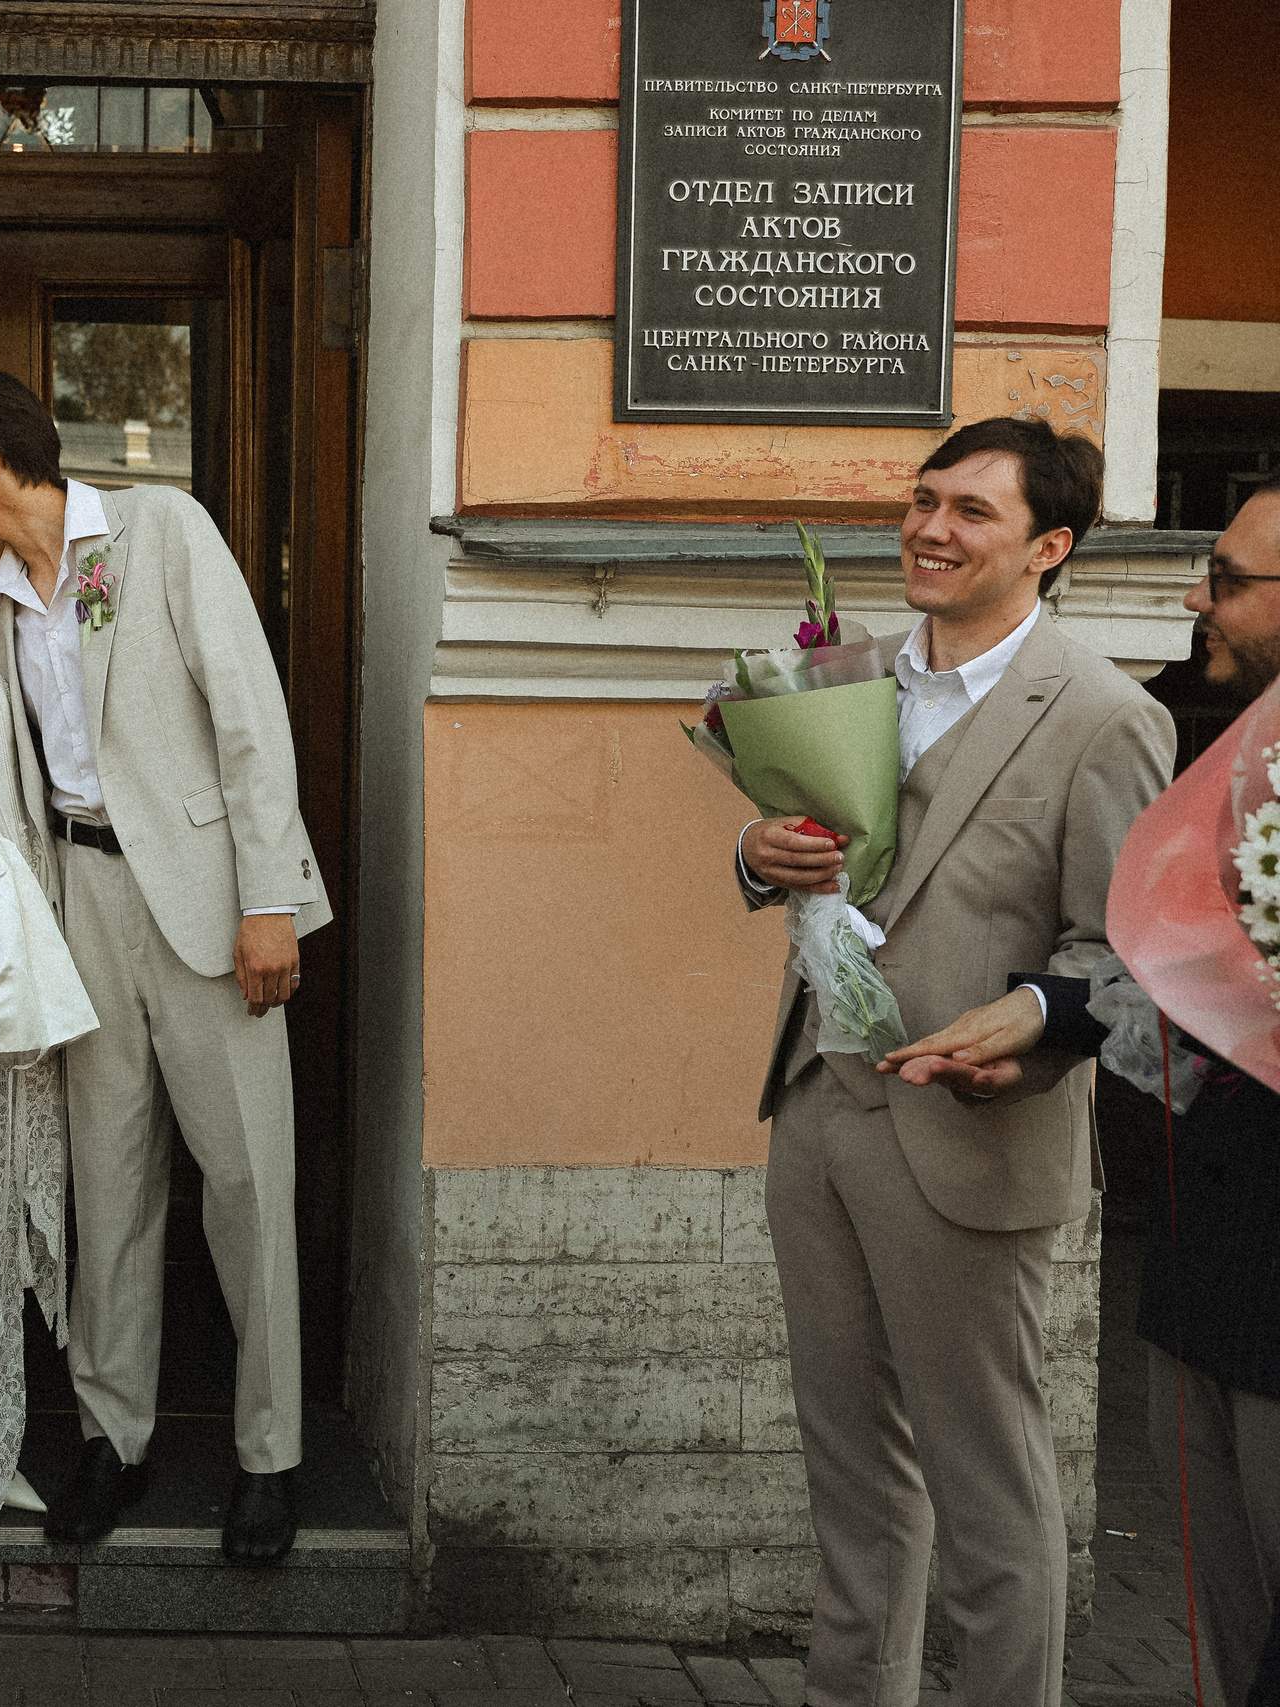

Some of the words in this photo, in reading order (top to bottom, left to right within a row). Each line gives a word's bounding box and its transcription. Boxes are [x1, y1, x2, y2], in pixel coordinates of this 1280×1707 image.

[644, 80, 778, 93] ПРАВИТЕЛЬСТВО
[790, 82, 942, 96] САНКТ-ПЕТЕРБУРГА
[710, 108, 783, 121] КОМИТЕТ
[792, 110, 813, 121] ПО
[821, 110, 877, 124] ДЕЛАМ
[664, 125, 727, 137] ЗАПИСИ
[737, 126, 785, 138] АКТОВ
[794, 127, 921, 141] ГРАЖДАНСКОГО
[745, 144, 840, 157] СОСТОЯНИЯ
[668, 180, 774, 207] ОТДЕЛ
[794, 182, 914, 205] ЗАПИСИ
[741, 216, 841, 239] АКТОВ
[662, 249, 916, 277] ГРАЖДАНСКОГО
[695, 285, 881, 309] СОСТОЯНИЯ
[643, 330, 829, 351] ЦЕНТРАЛЬНОГО
[841, 331, 930, 351] РАЙОНА
[667, 355, 905, 374] САНКТ-ПЕТЕРБУРГА
